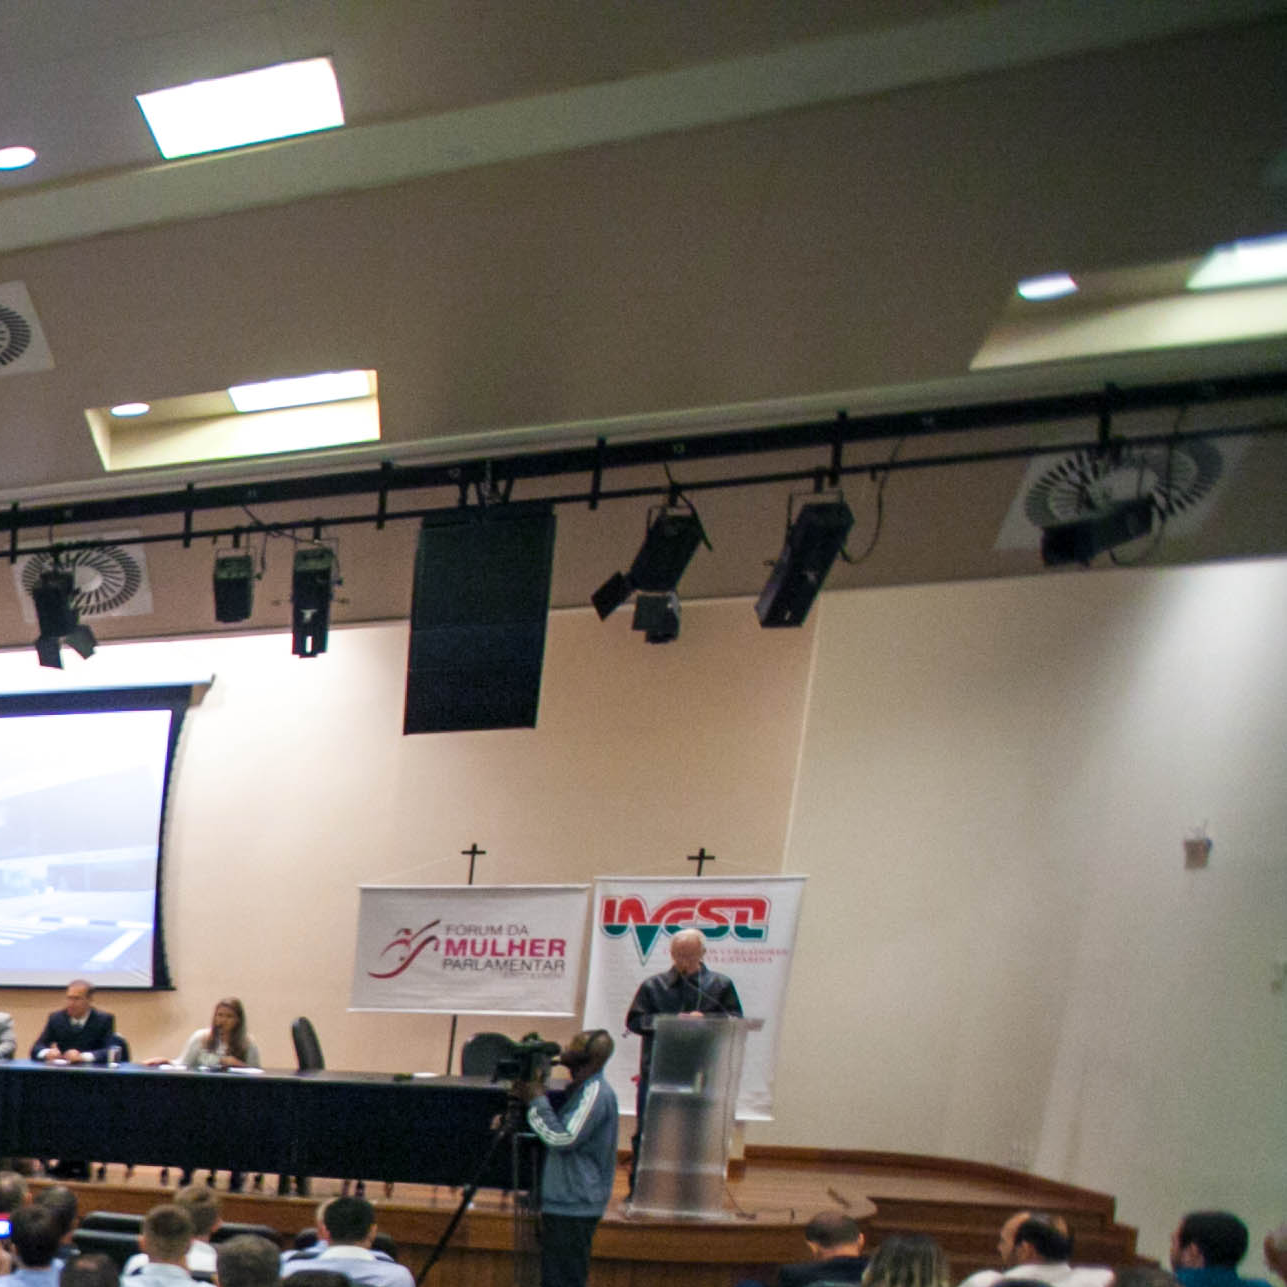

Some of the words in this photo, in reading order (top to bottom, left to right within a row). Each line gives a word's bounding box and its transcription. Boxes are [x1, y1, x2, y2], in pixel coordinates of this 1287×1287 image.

[507, 925, 529, 936] DA
[445, 938, 567, 957] MULHER
[443, 958, 566, 972] PARLAMENTAR
